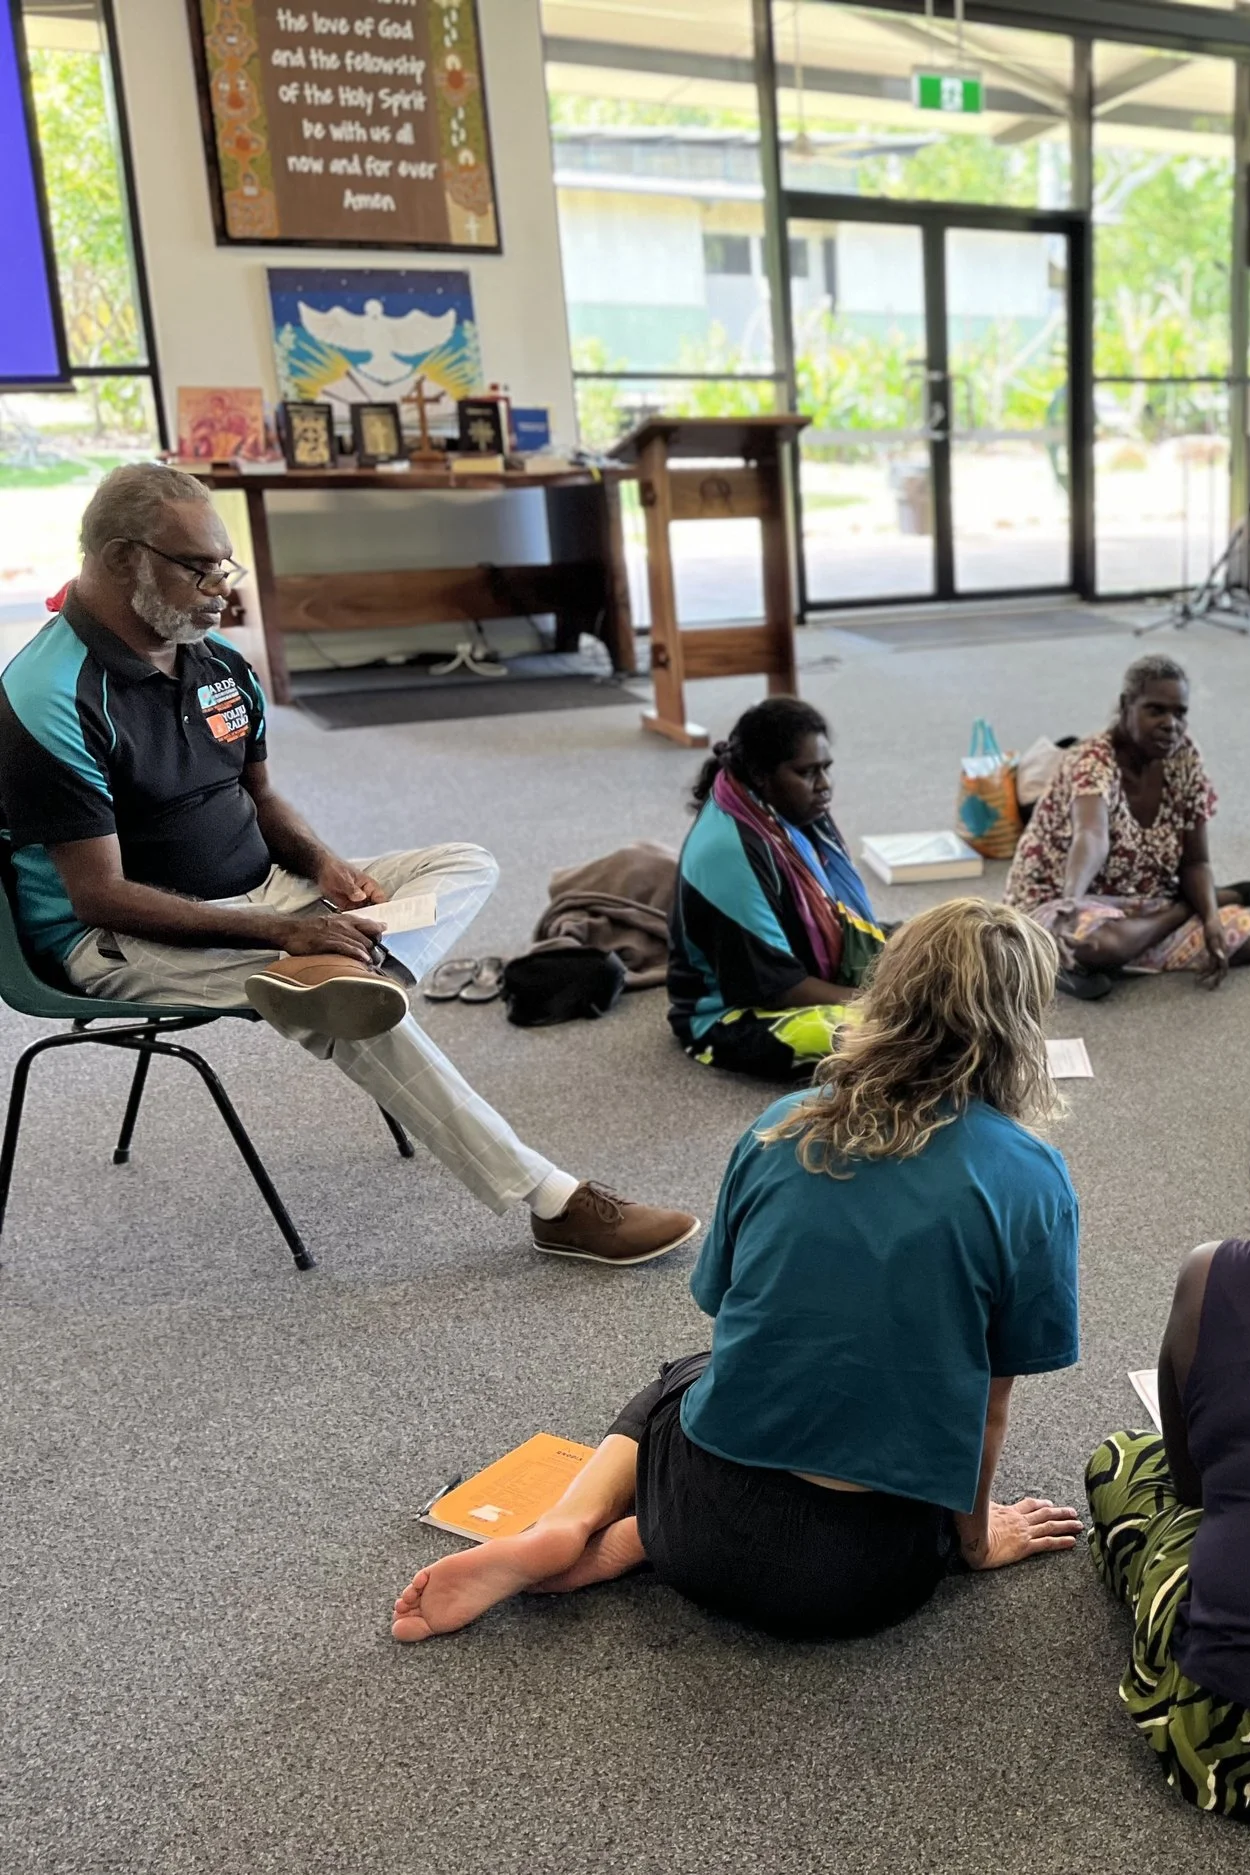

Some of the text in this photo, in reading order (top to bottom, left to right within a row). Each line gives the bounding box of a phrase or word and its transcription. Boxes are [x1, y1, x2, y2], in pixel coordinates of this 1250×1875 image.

[276, 8, 414, 40] the love of God
[271, 47, 426, 84] and the fellowship
[278, 82, 427, 117] of the Holy Spirit
[302, 118, 415, 144] be with us all
[287, 154, 437, 180] now and for ever
[343, 188, 396, 212] Amen
[209, 678, 235, 694] ARDS
[226, 715, 249, 731] RADIO
